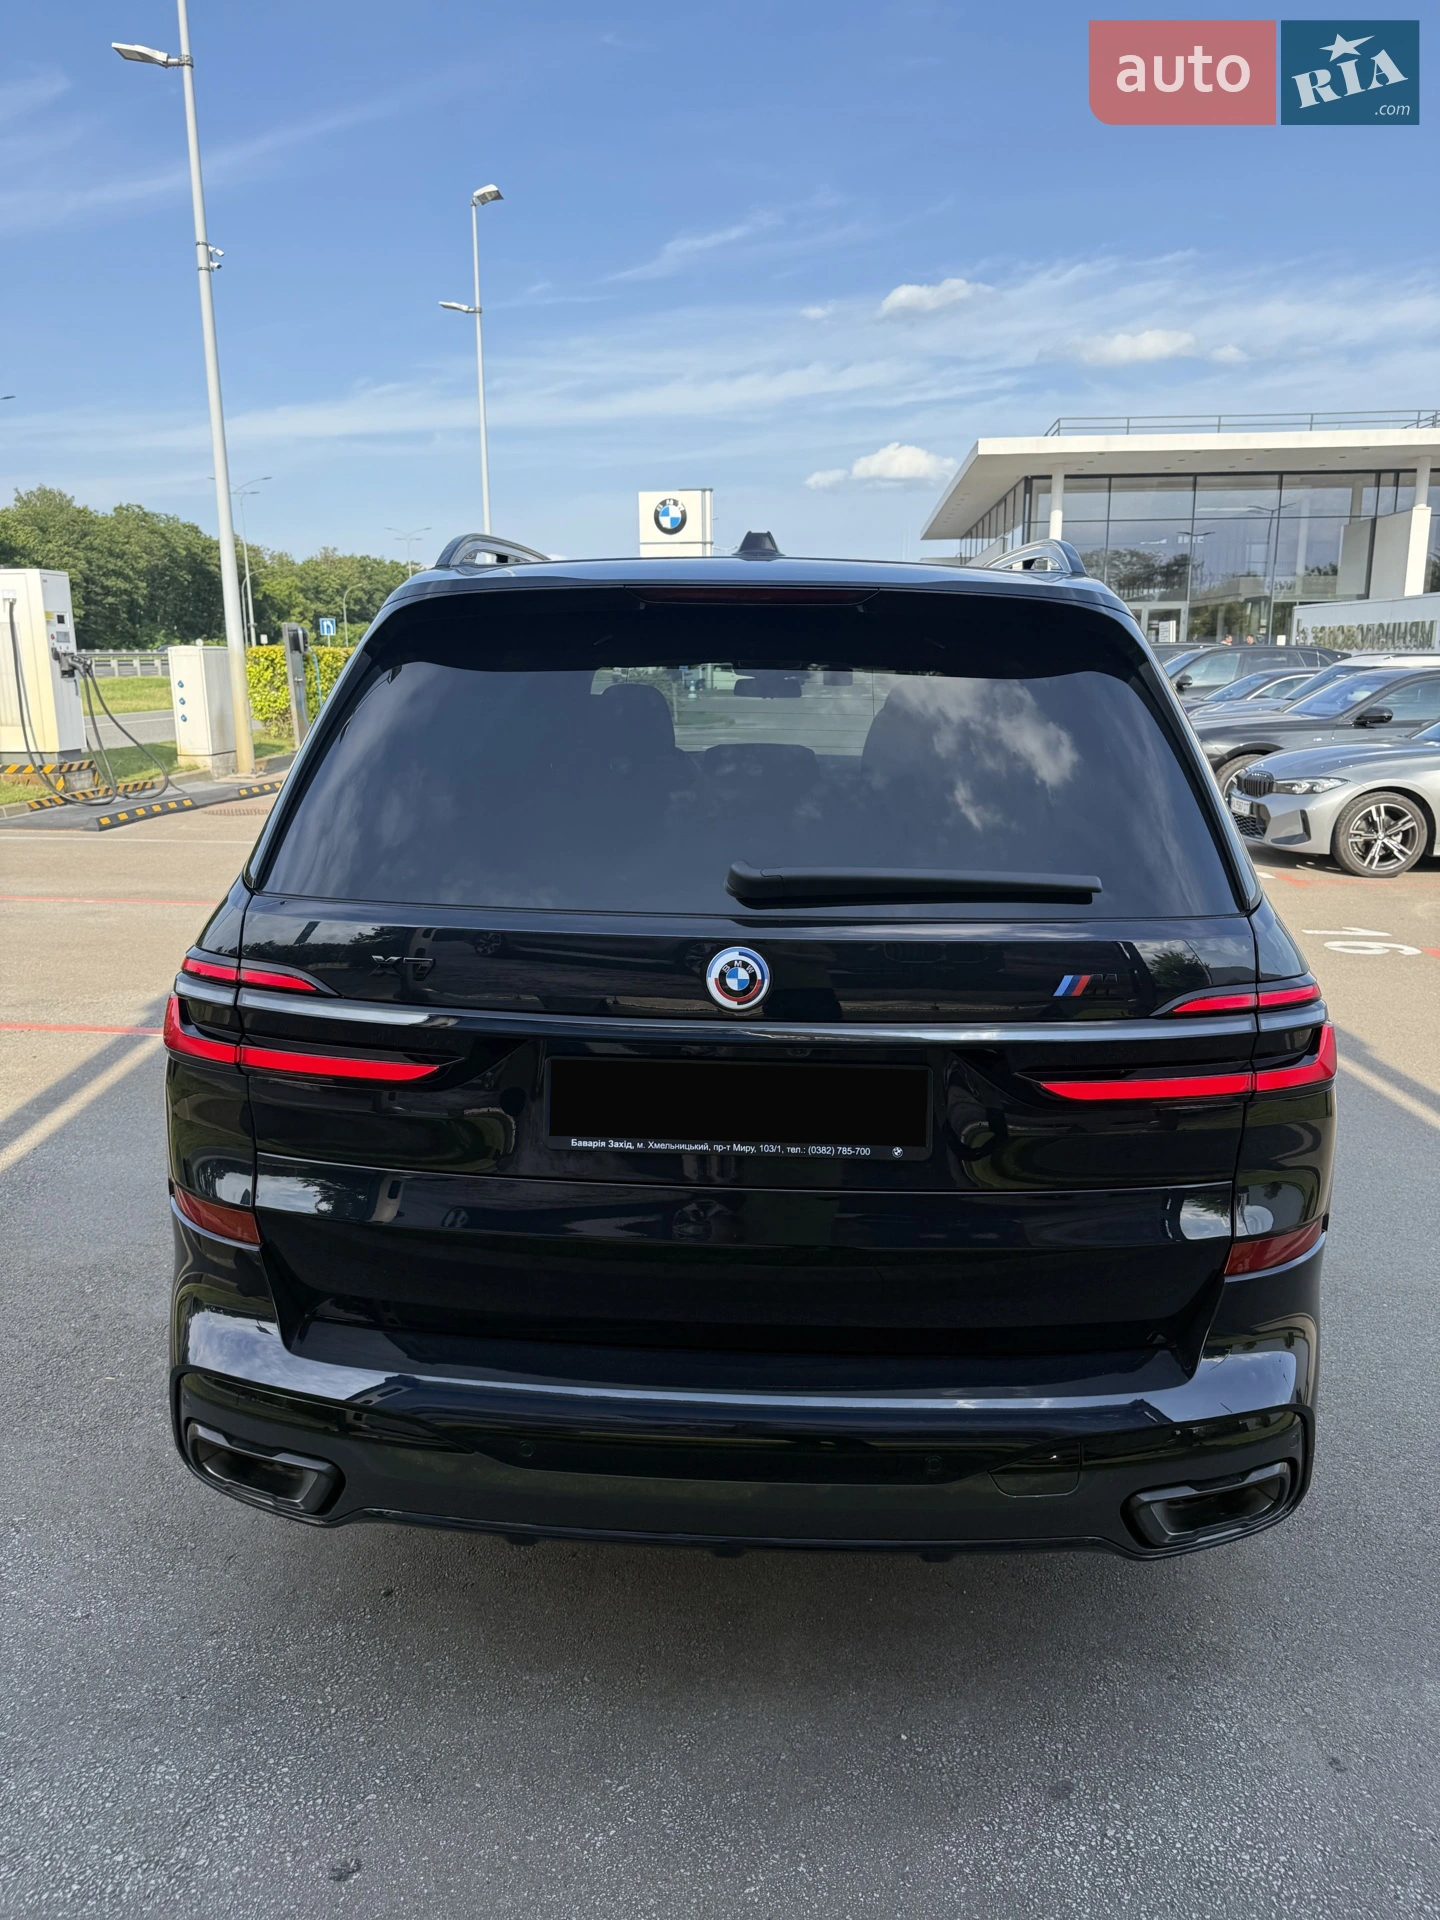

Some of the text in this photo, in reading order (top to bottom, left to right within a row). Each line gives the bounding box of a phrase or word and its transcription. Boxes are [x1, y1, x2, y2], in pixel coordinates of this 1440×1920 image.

[721, 960, 755, 974] BMW
[571, 1138, 606, 1149] Баварія
[608, 1140, 635, 1150] Захід,
[648, 1141, 711, 1152] Хмельницький,
[713, 1144, 731, 1152] пр-т
[733, 1144, 757, 1154] Миру,
[759, 1144, 784, 1154] 103/1,
[808, 1146, 835, 1156] (0382)
[837, 1147, 871, 1156] 785-700
